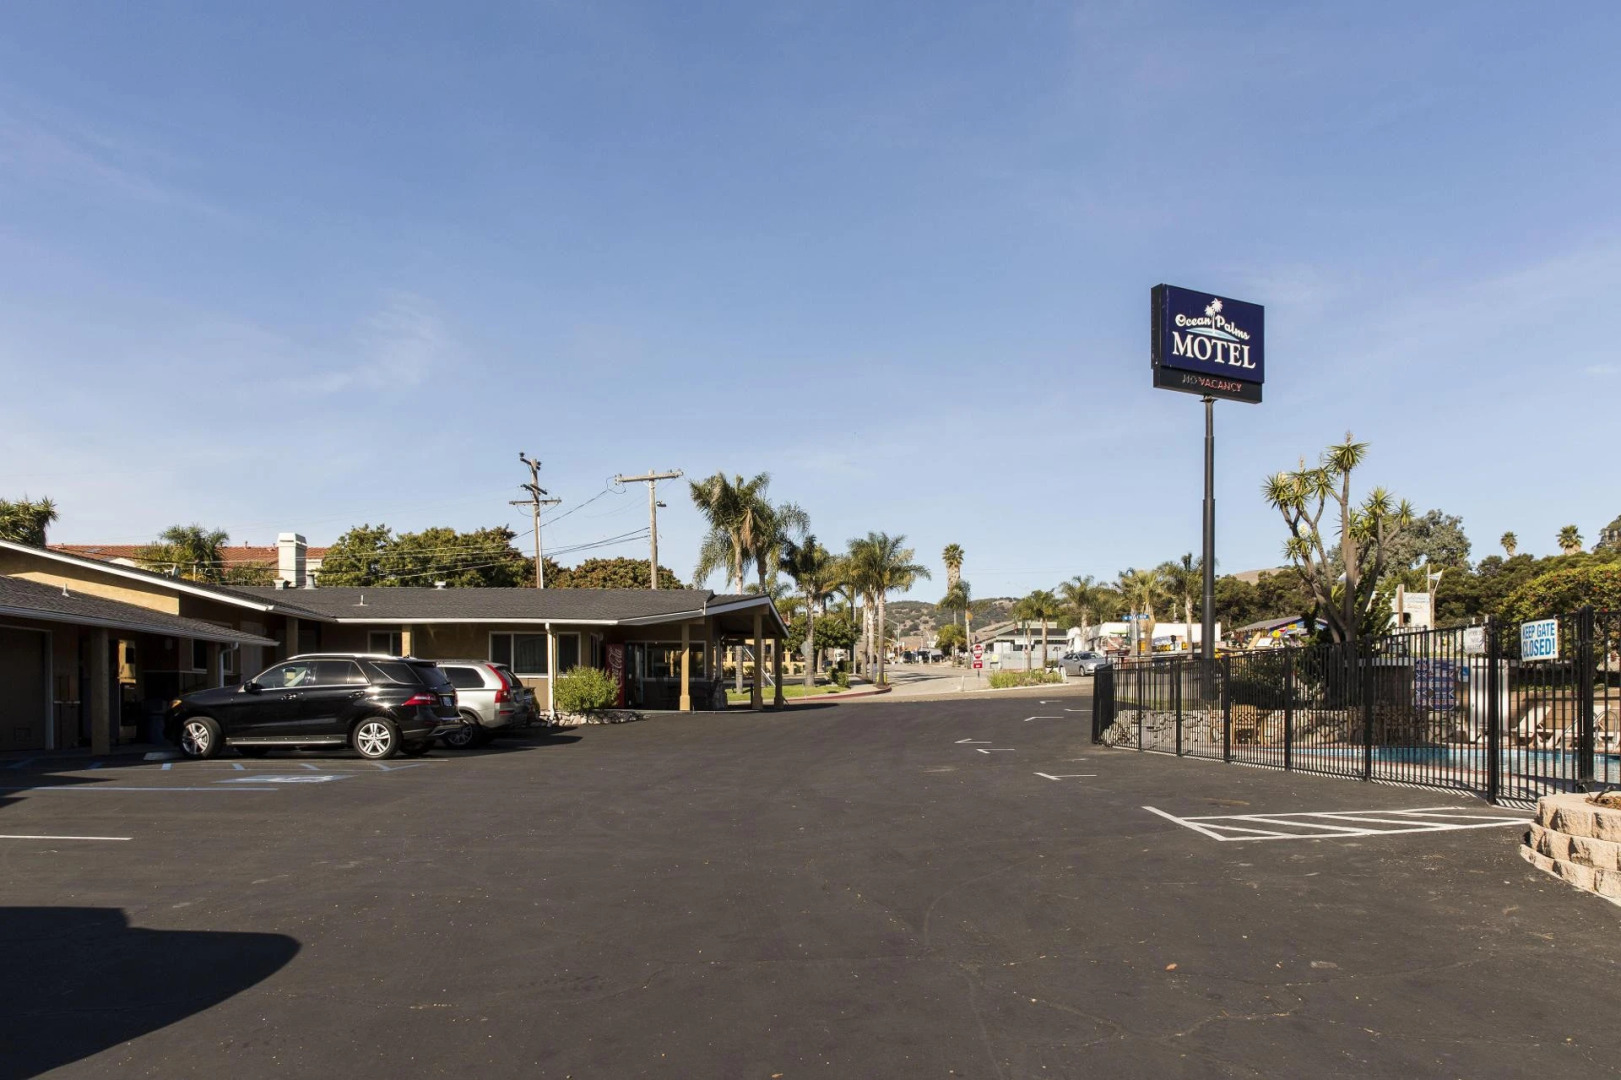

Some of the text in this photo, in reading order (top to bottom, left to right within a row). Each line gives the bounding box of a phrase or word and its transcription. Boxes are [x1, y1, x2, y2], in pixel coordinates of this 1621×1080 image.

[1175, 314, 1250, 340] Ocean Palms
[1172, 331, 1256, 369] MOTEL
[1182, 374, 1242, 392] NO VACANCY
[1523, 623, 1555, 639] KEEP GATE
[1523, 638, 1555, 657] CLOSED!
